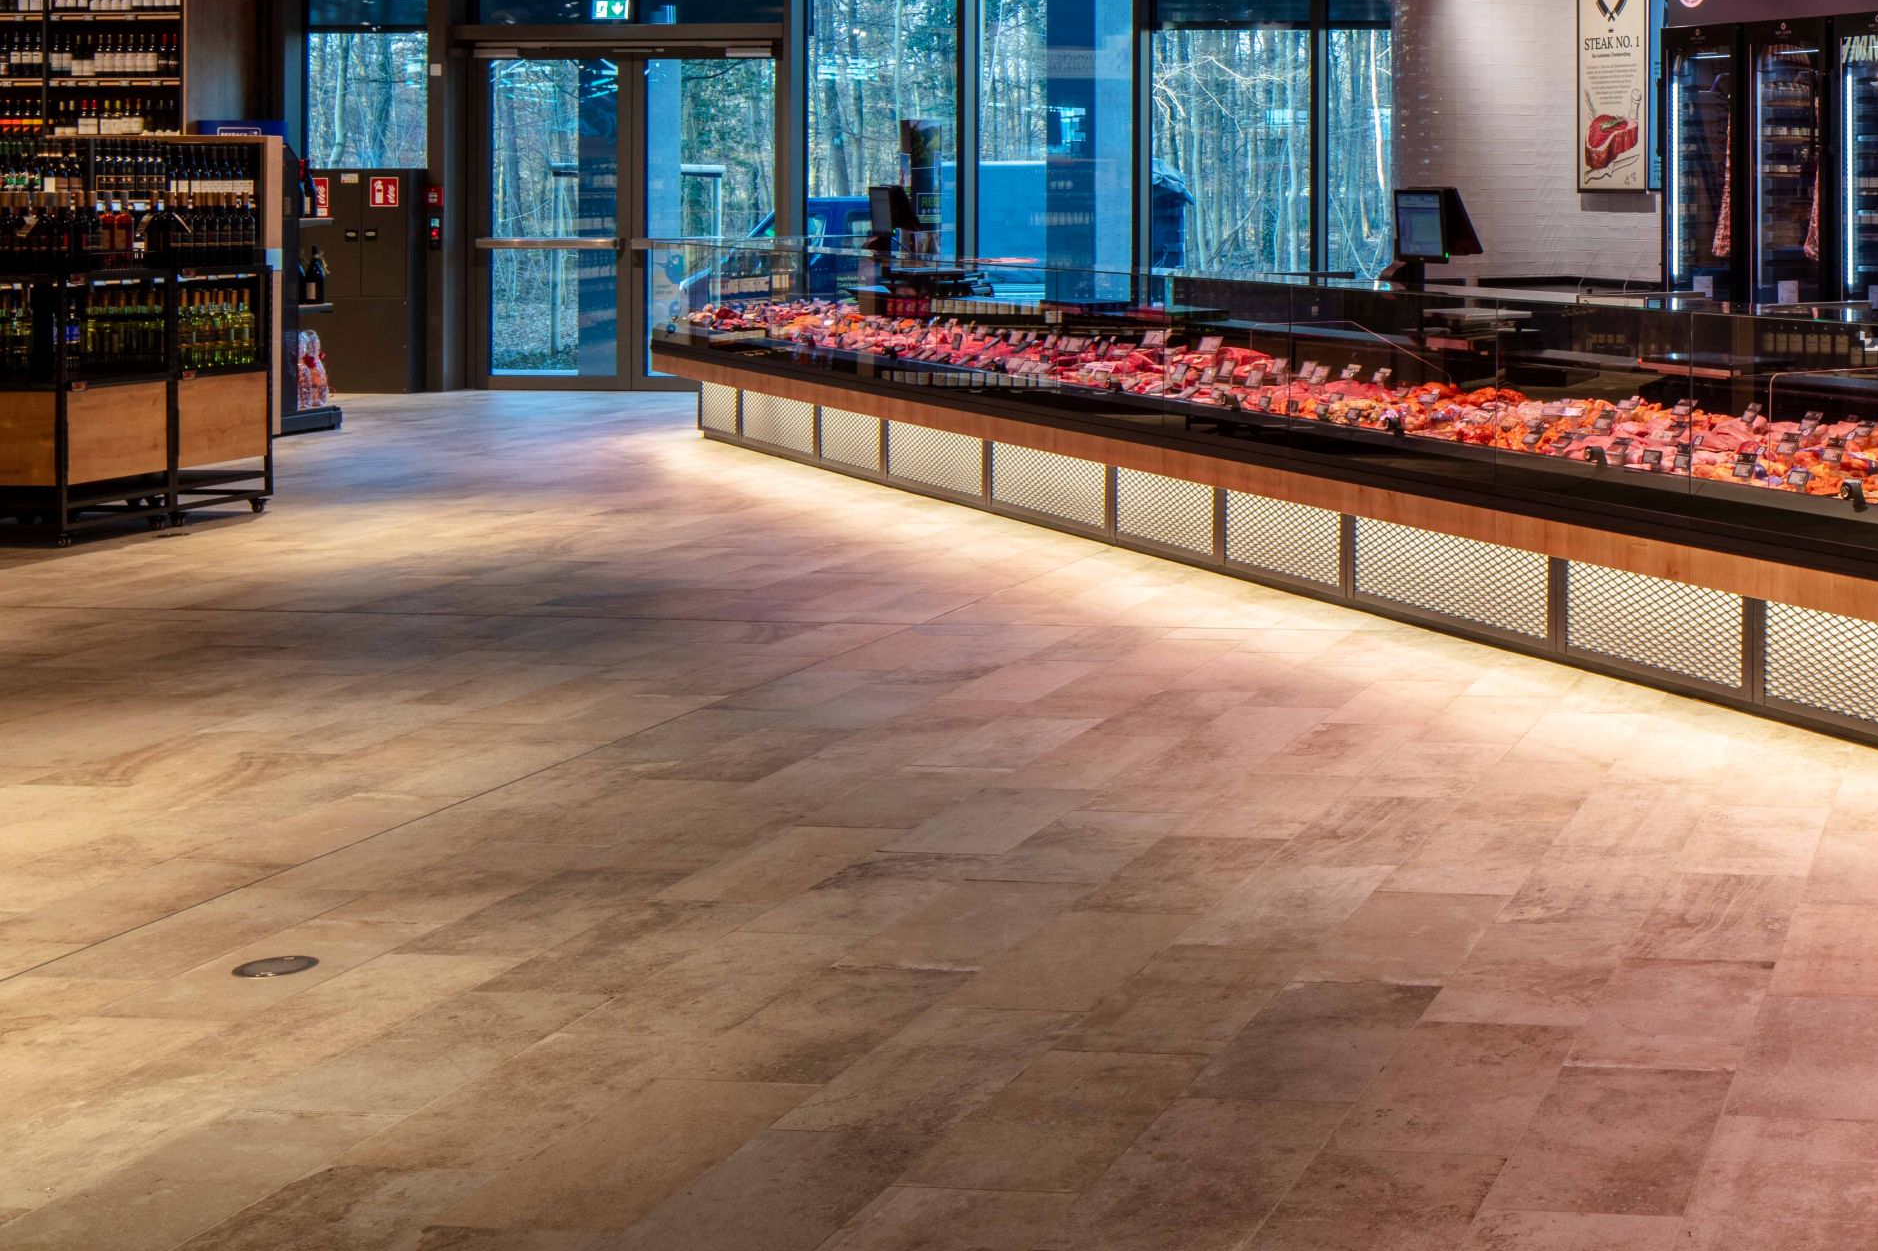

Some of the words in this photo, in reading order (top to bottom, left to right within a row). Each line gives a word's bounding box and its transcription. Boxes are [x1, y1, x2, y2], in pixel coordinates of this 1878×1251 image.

[1584, 36, 1613, 51] STEAK
[1616, 35, 1632, 49] NO.
[1636, 36, 1640, 47] 1
